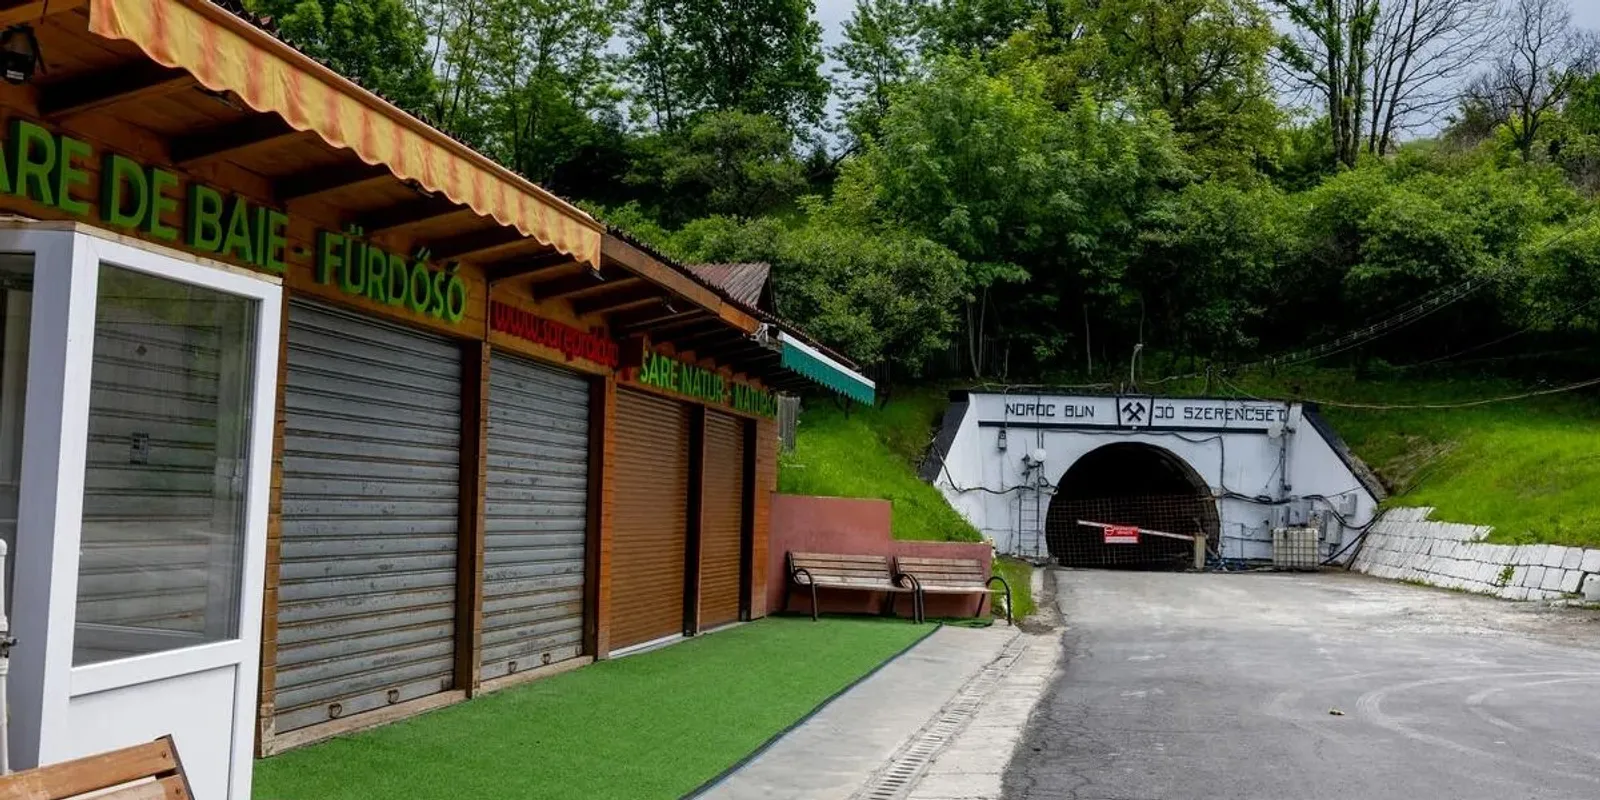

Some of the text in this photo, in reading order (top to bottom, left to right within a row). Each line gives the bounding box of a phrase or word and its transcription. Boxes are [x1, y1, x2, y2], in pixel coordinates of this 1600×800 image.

[0, 119, 93, 217] RE
[109, 152, 180, 241] DE
[193, 184, 290, 273] BAIE
[640, 351, 679, 391] SARE
[682, 362, 724, 404] NATUR
[1005, 402, 1056, 418] NOROC
[1064, 404, 1095, 418] BUN
[1154, 402, 1175, 419] JÓ
